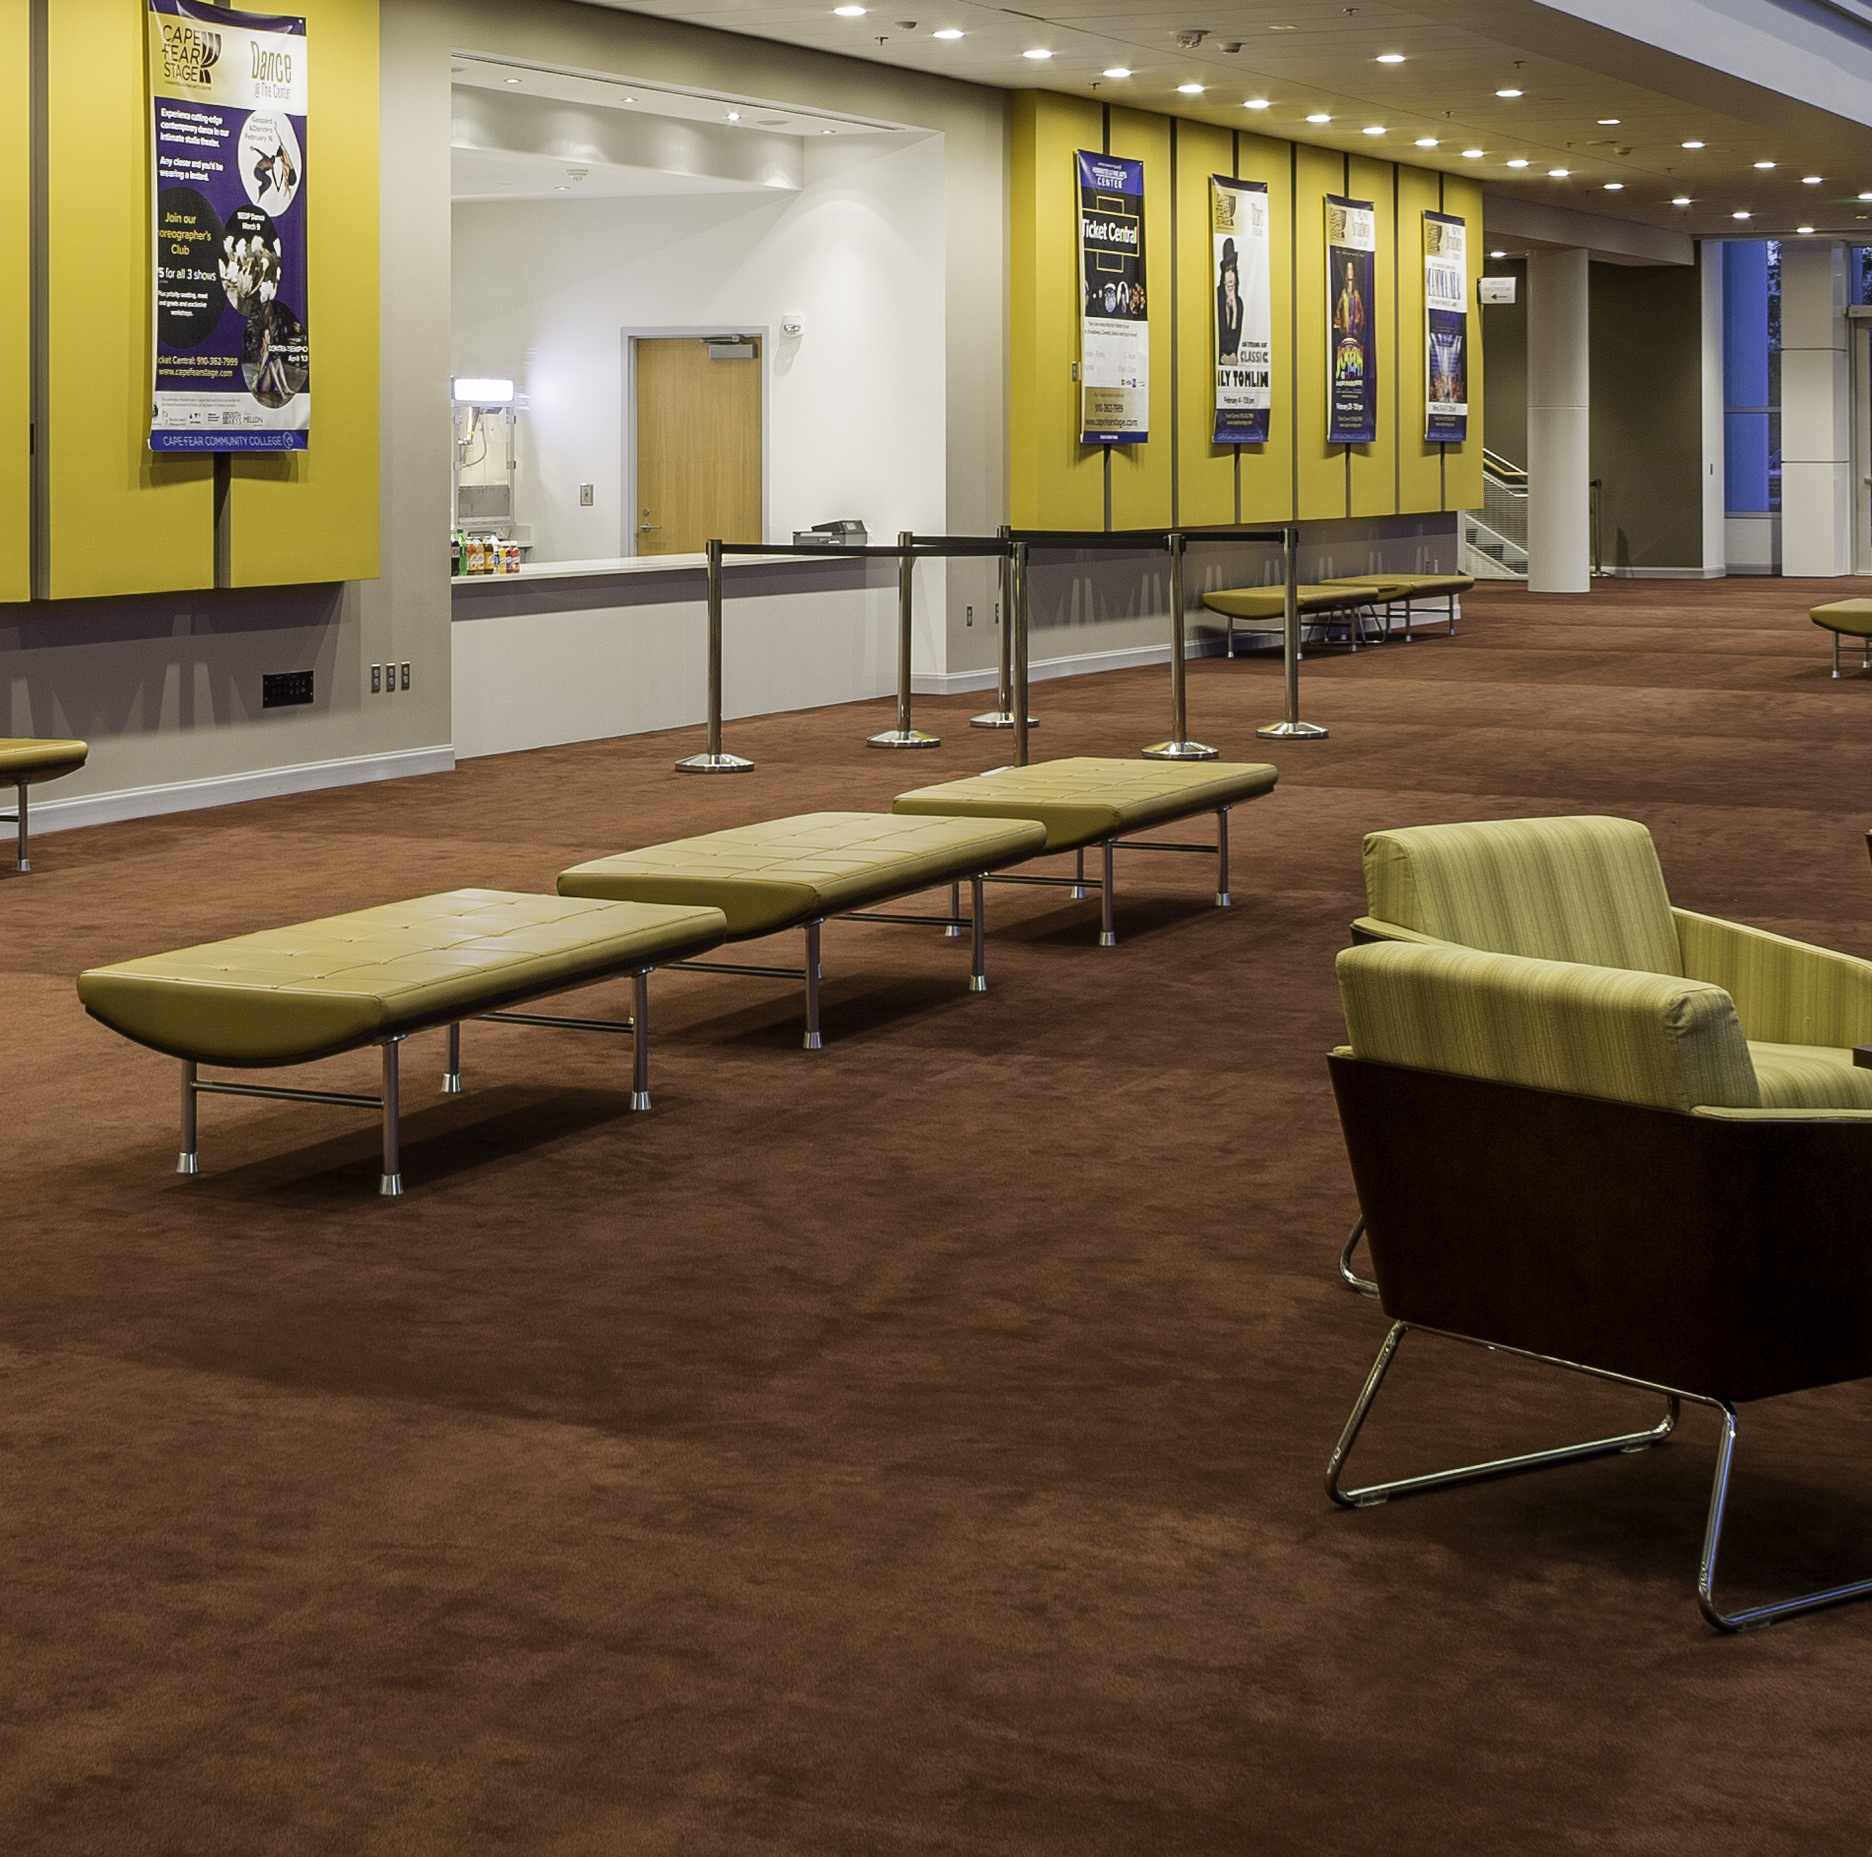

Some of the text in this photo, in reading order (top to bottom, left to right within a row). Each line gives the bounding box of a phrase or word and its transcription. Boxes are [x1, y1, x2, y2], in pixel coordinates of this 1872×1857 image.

[162, 25, 201, 46] CAPE
[161, 43, 201, 65] FEAR
[250, 41, 292, 83] Dance
[164, 61, 199, 82] STAGE
[1097, 177, 1123, 189] CENTER
[165, 212, 196, 224] Join our
[1081, 218, 1138, 244] Ticket Central
[171, 244, 190, 255] Club
[166, 267, 175, 278] for
[176, 268, 186, 279] all
[187, 268, 193, 280] 3
[193, 269, 217, 281] shows
[1240, 350, 1269, 363] CLASSIC
[1218, 370, 1269, 387] ILY TOMLIN
